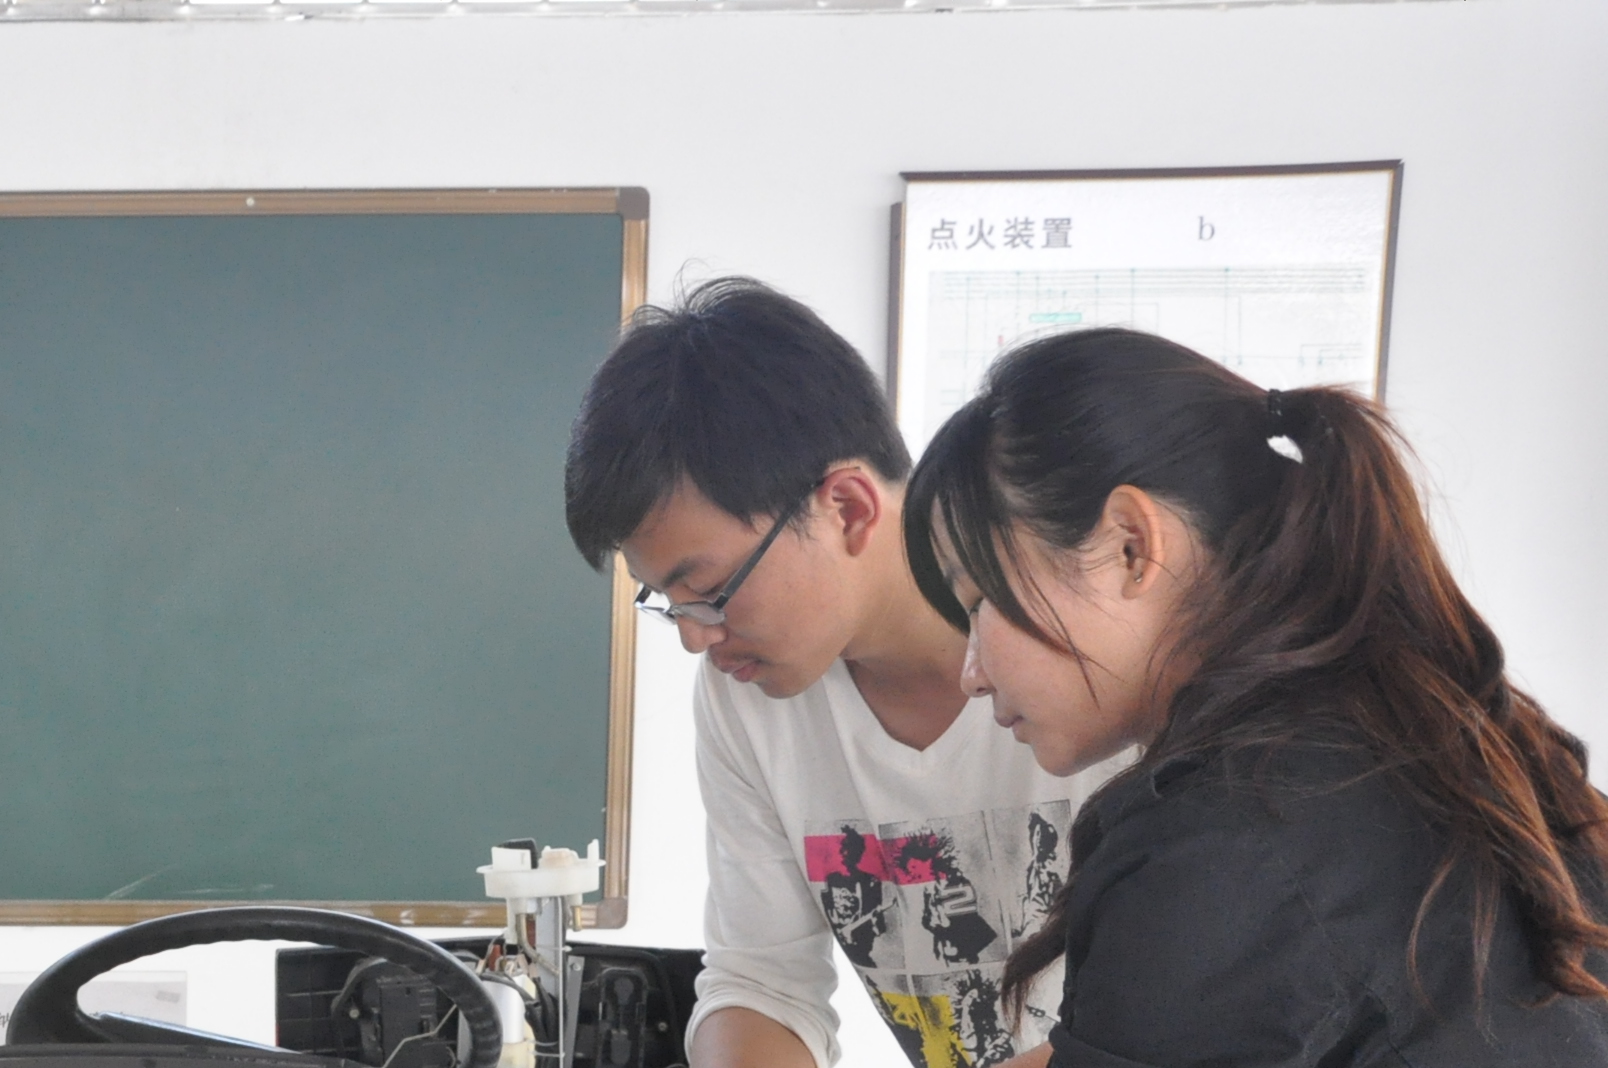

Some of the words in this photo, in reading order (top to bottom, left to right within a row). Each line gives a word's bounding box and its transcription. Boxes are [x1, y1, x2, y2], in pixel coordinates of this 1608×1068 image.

[927, 216, 1073, 251] 点火装置
[1197, 215, 1217, 241] b
